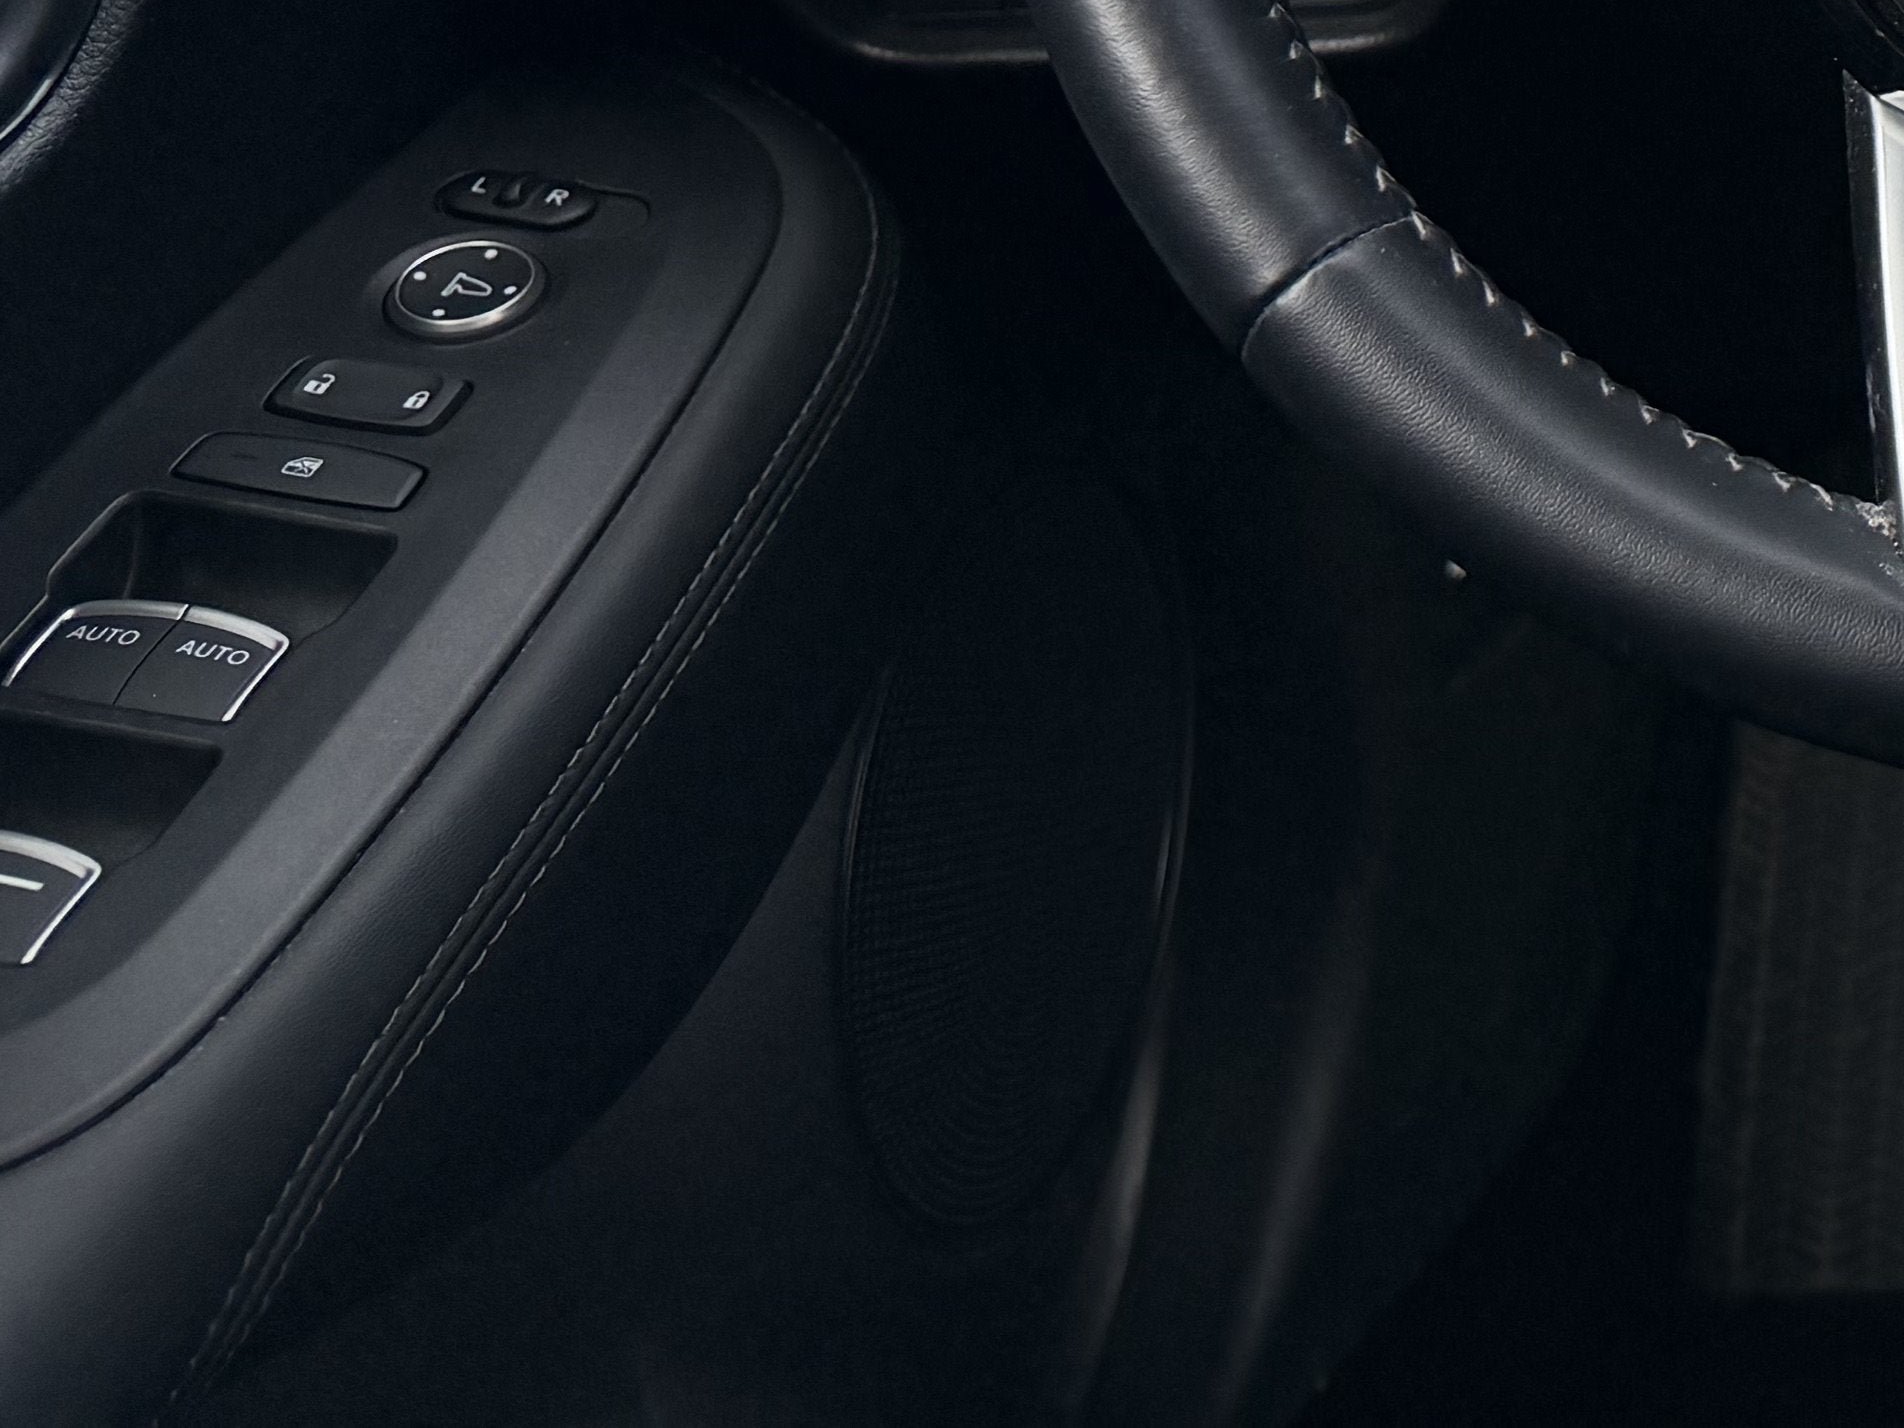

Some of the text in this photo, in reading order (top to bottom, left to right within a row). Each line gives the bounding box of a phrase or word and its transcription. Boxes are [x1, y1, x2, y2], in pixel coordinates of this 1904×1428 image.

[470, 175, 571, 207] L R
[65, 624, 142, 646] AUTO
[175, 639, 251, 666] AUTO
